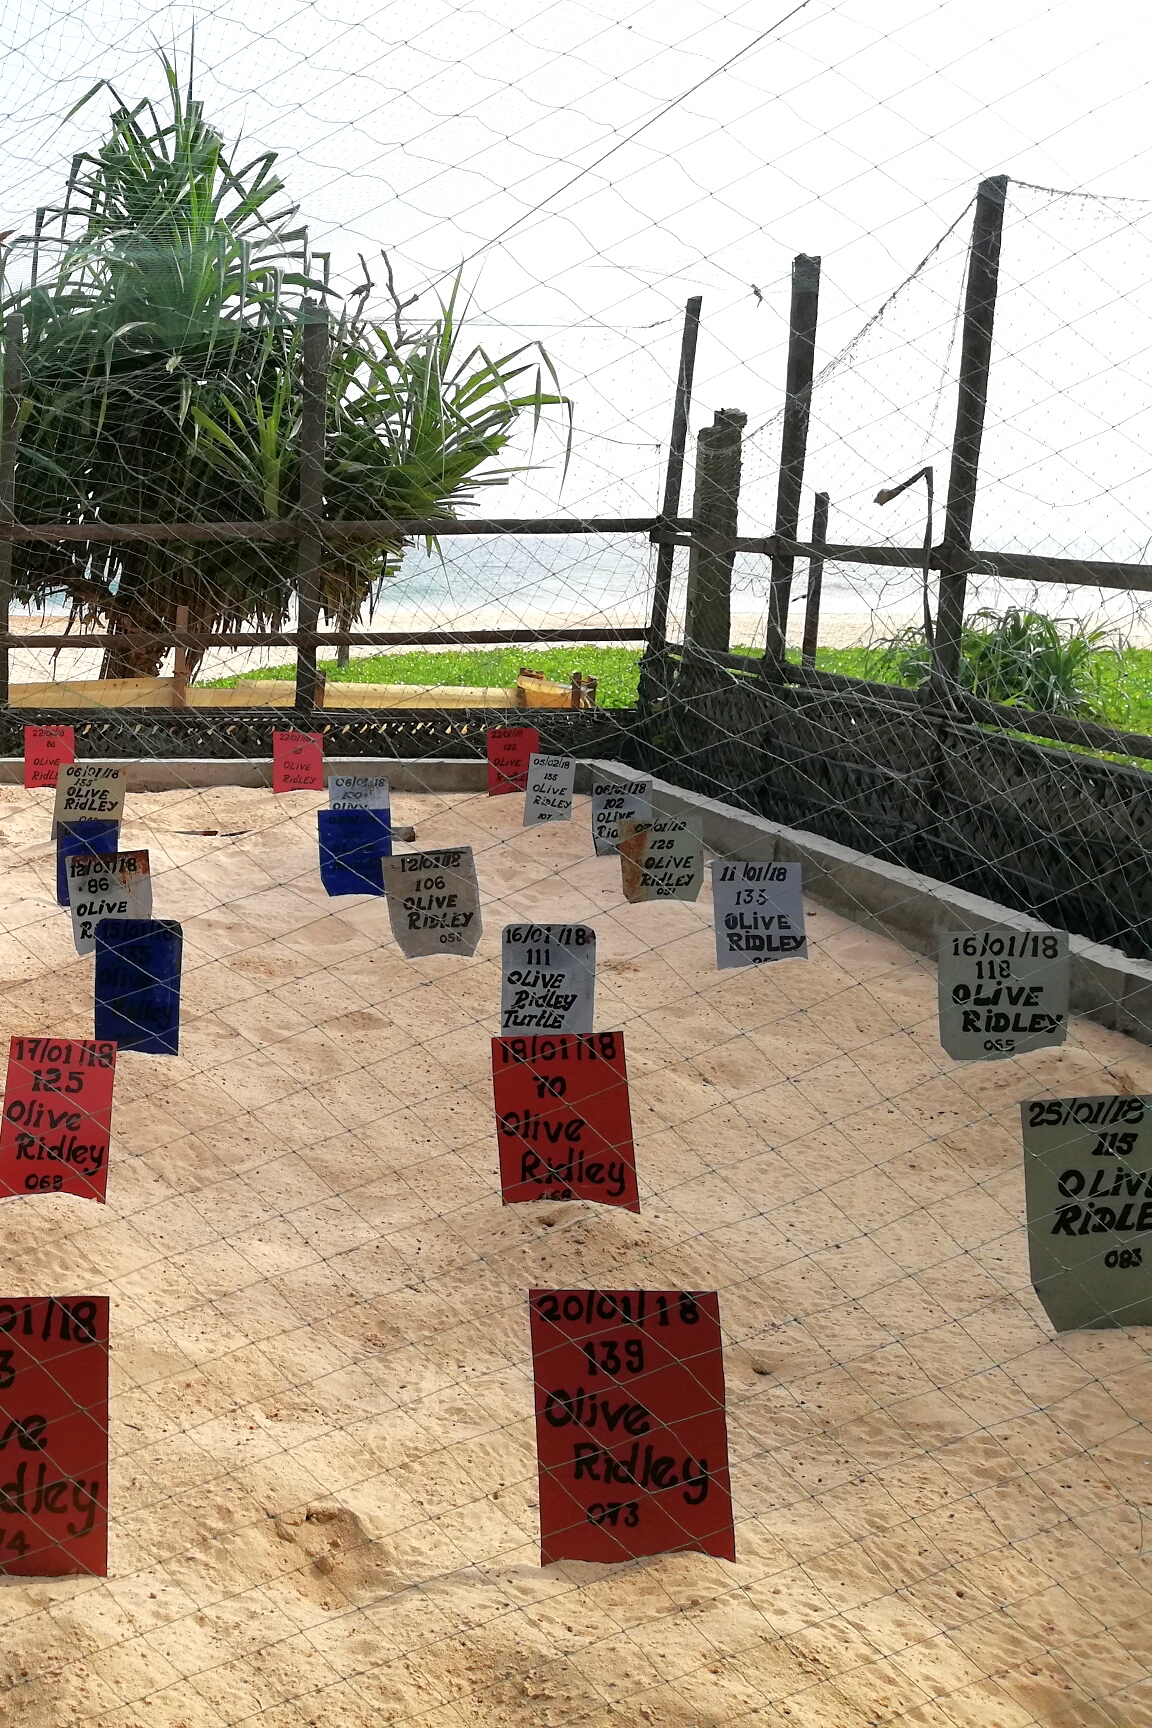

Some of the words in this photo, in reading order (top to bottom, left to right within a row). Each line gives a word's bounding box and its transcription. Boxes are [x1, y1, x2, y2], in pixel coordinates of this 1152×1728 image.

[603, 797, 625, 810] 102
[87, 877, 110, 894] 86
[415, 876, 446, 892] 106
[526, 948, 551, 966] 111
[952, 932, 1059, 959] 16/01/18
[975, 960, 1011, 980] 118
[32, 1067, 85, 1093] 125
[532, 1075, 567, 1099] 70
[6, 1099, 82, 1132] Olive
[1029, 1095, 1145, 1128] 25/01/18
[1091, 1132, 1139, 1156] 115
[583, 1339, 646, 1377] 139
[544, 1386, 651, 1435] Olive
[573, 1442, 709, 1506] Ridley
[587, 1502, 640, 1528] 073
